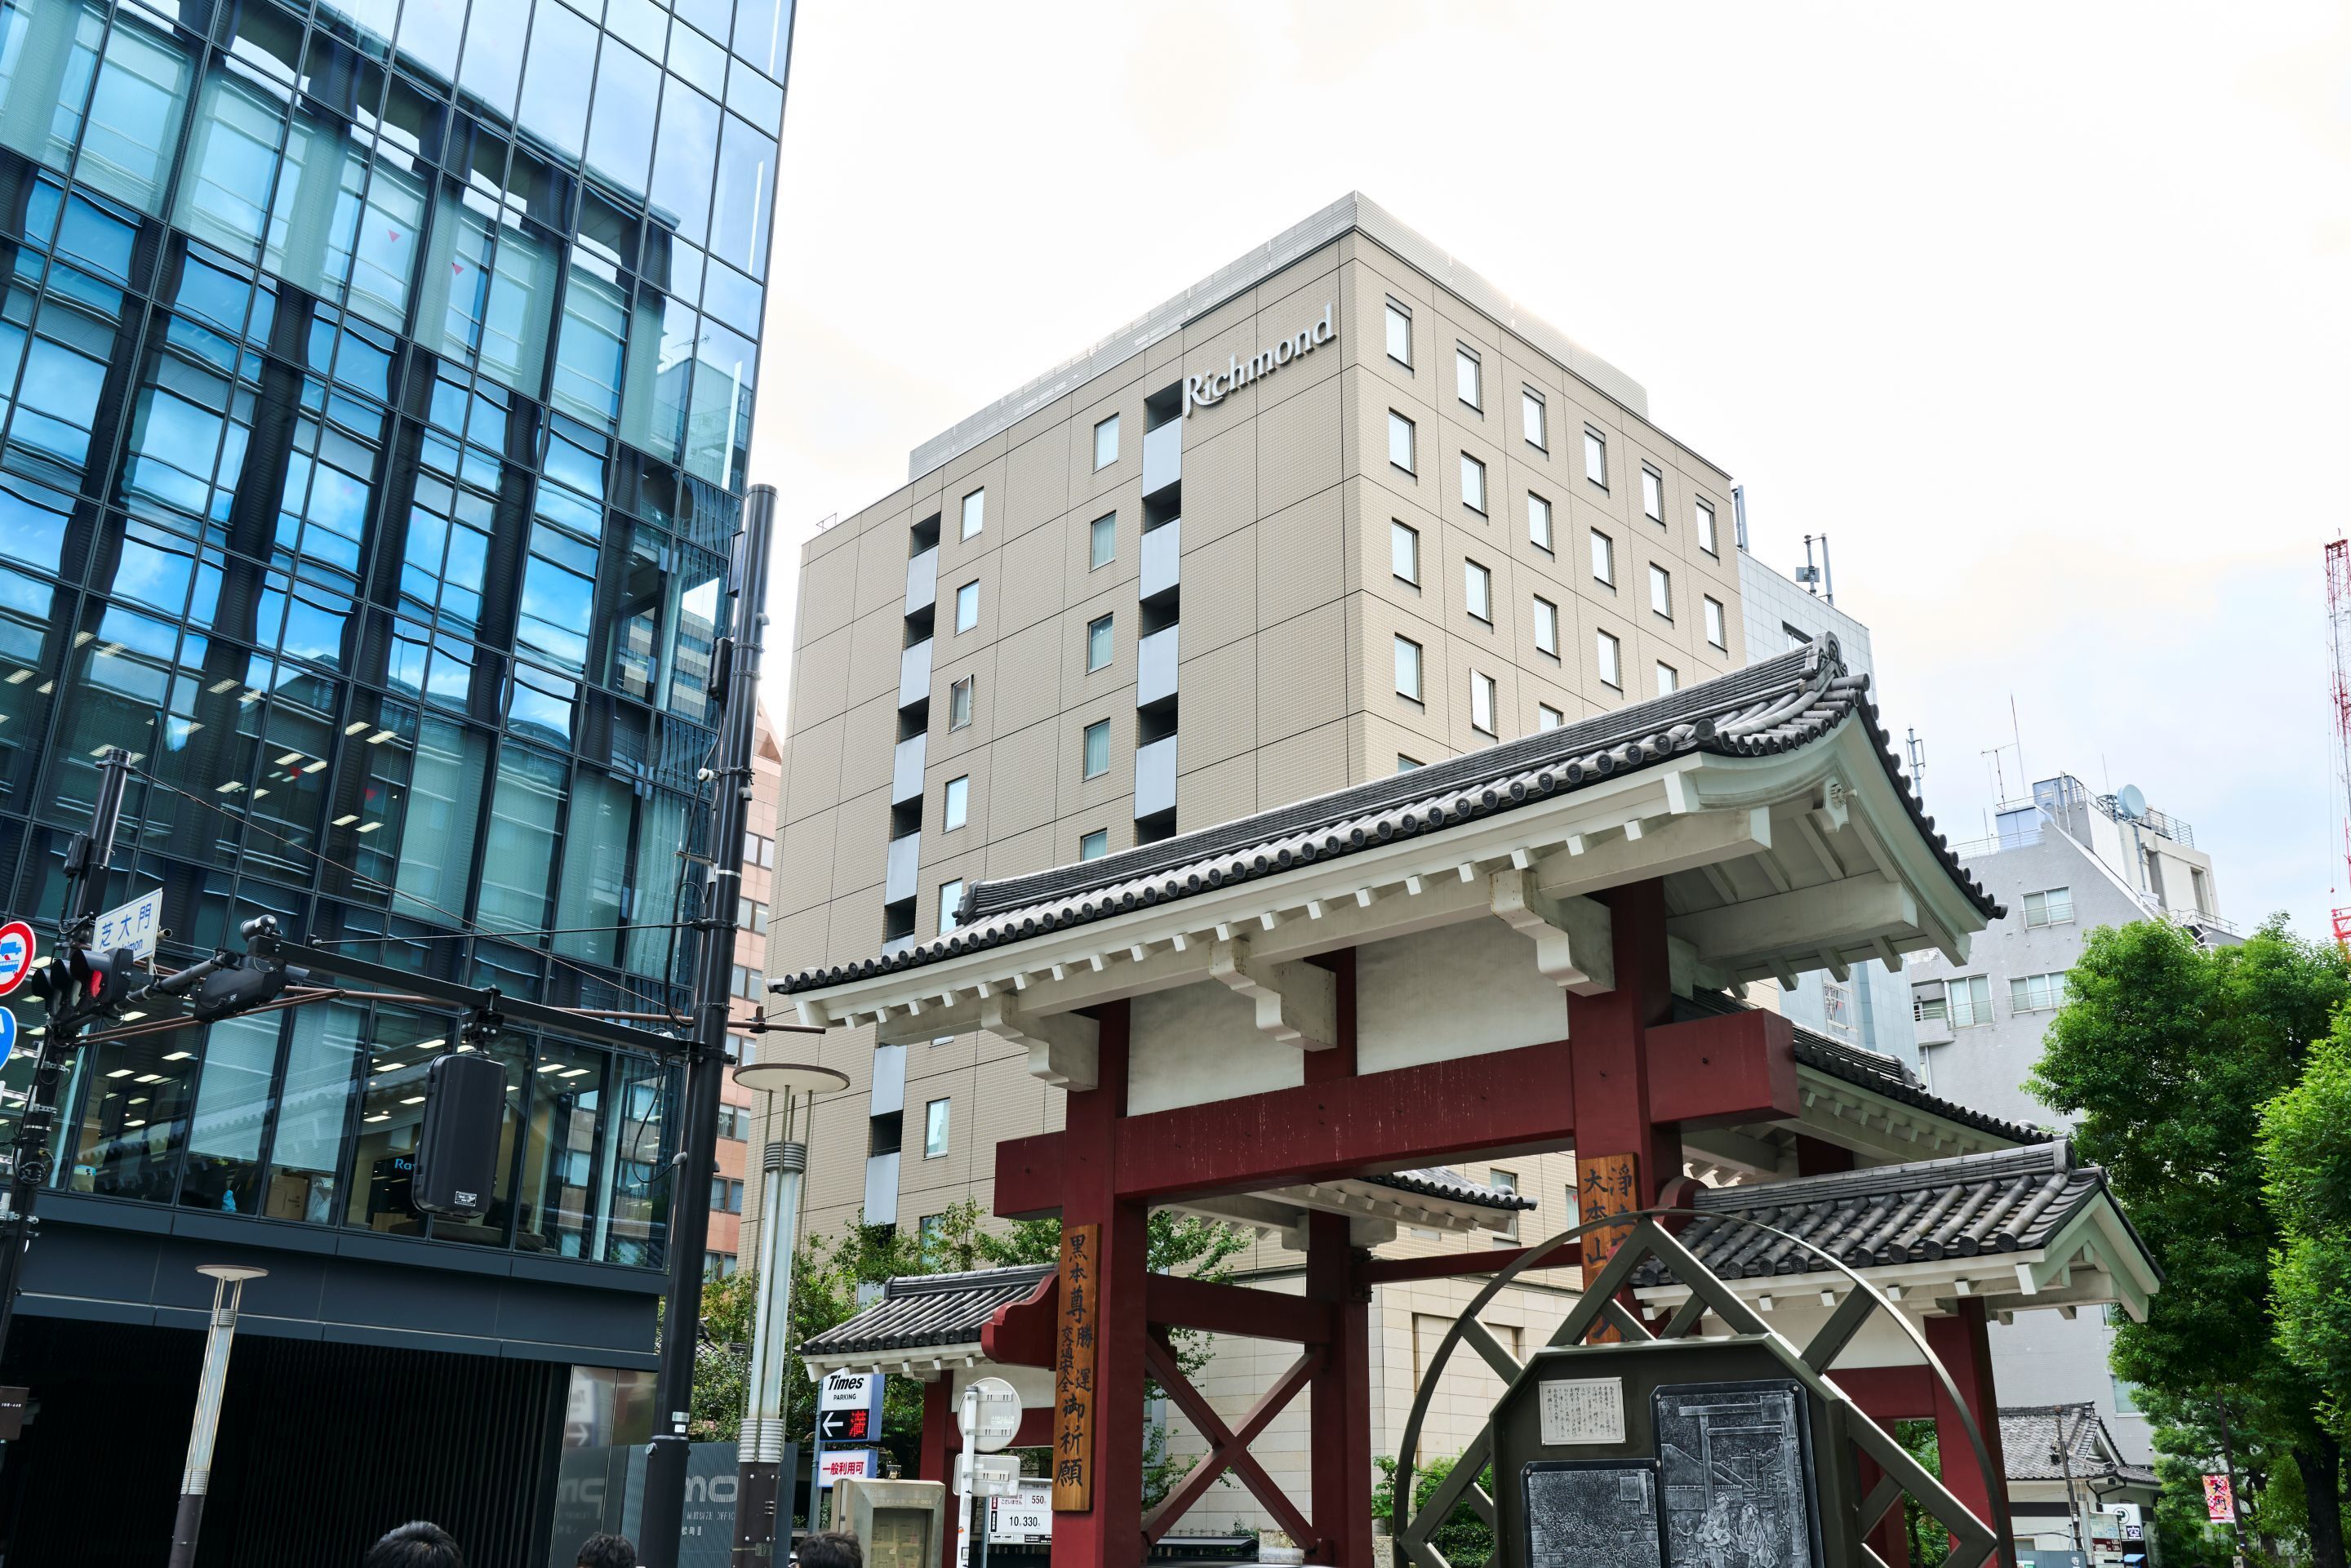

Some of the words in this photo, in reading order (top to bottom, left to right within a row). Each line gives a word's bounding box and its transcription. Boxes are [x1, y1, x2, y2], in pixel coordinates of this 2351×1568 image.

[1184, 301, 1336, 418] Richmond
[100, 903, 152, 949] 芝大門
[1058, 1325, 1074, 1392] 交通安全
[828, 1375, 864, 1390] Times
[849, 1410, 867, 1437] 満
[1056, 1393, 1085, 1487] 御祈願
[822, 1461, 864, 1475] 一般利用可
[2213, 1482, 2227, 1510] 大門
[2127, 1526, 2141, 1539] 空
